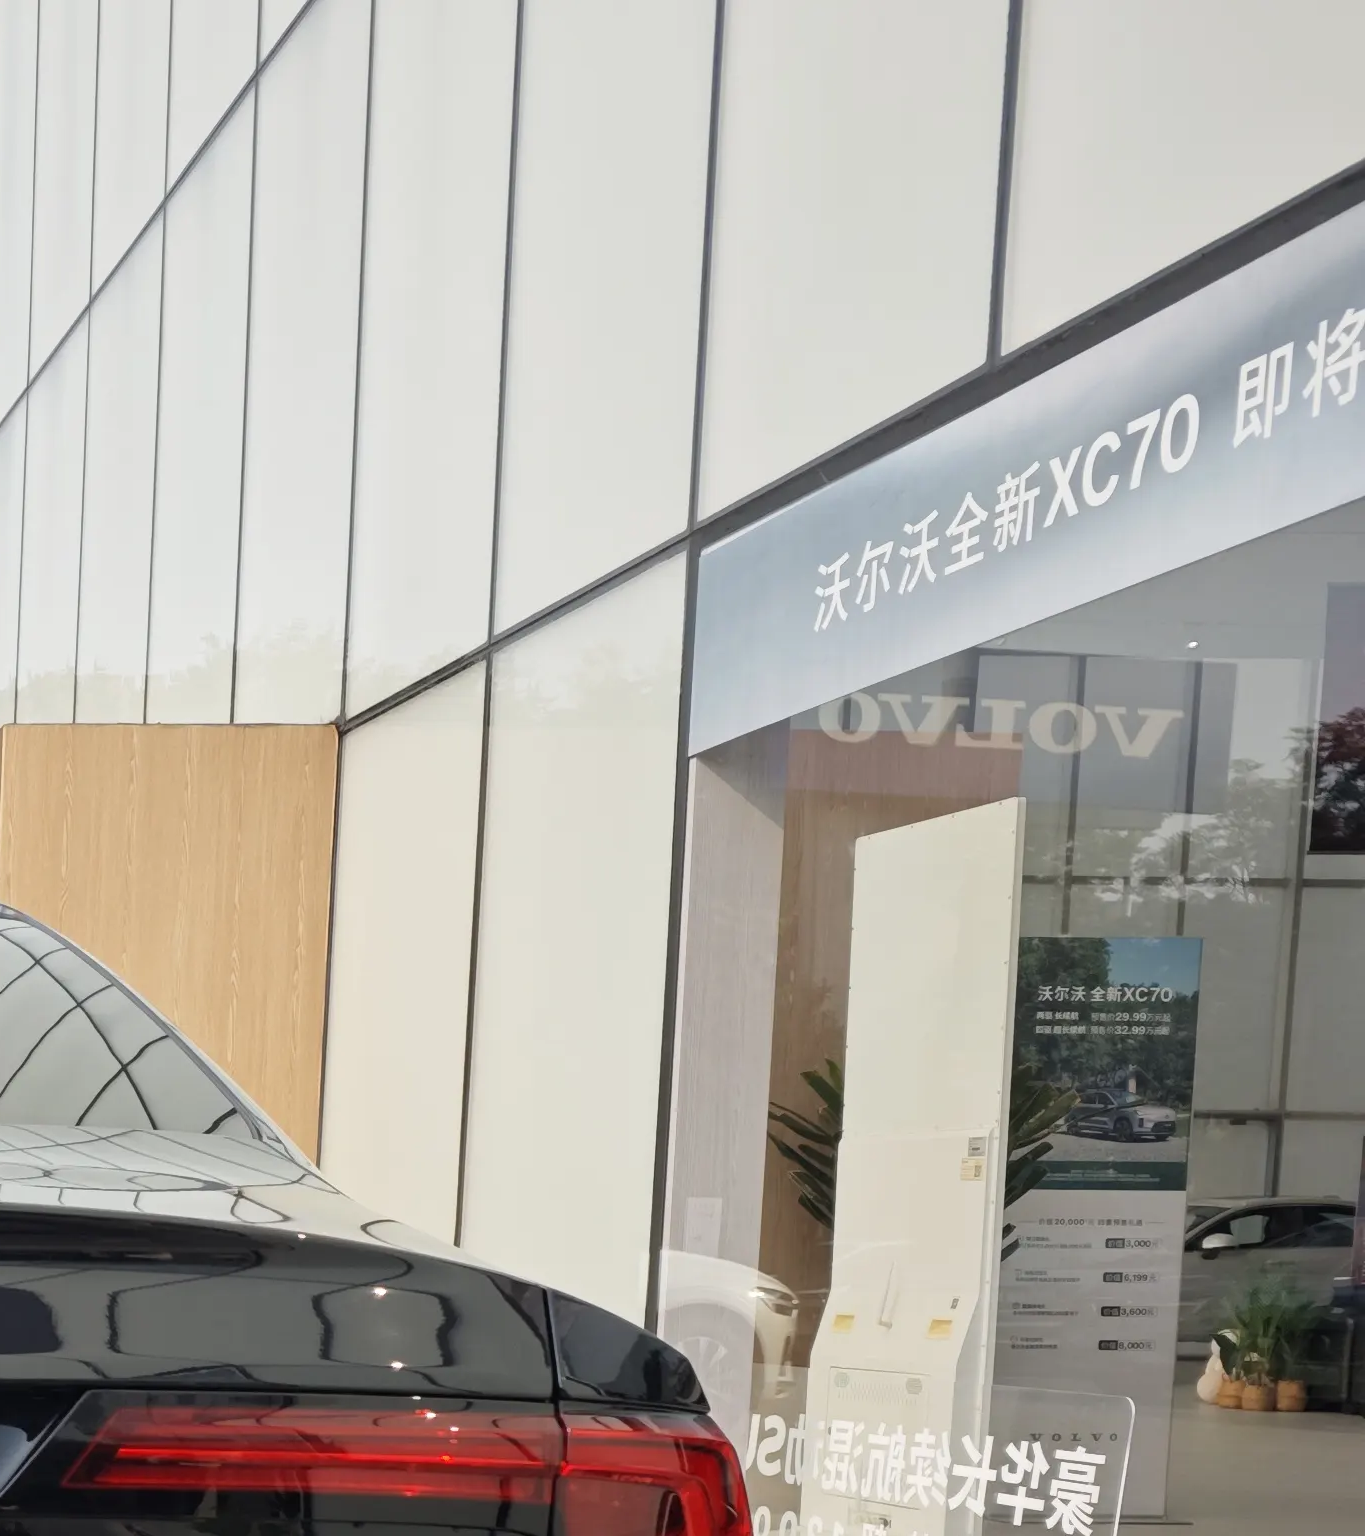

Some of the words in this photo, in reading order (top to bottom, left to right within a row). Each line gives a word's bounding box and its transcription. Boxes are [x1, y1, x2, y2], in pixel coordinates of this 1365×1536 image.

[812, 393, 1201, 633] 沃尔沃全新XC70
[1232, 307, 1365, 449] 即将
[1037, 985, 1087, 1002] 沃尔沃
[1090, 986, 1173, 1003] 全新XC70
[1029, 1432, 1119, 1442] VOLVO
